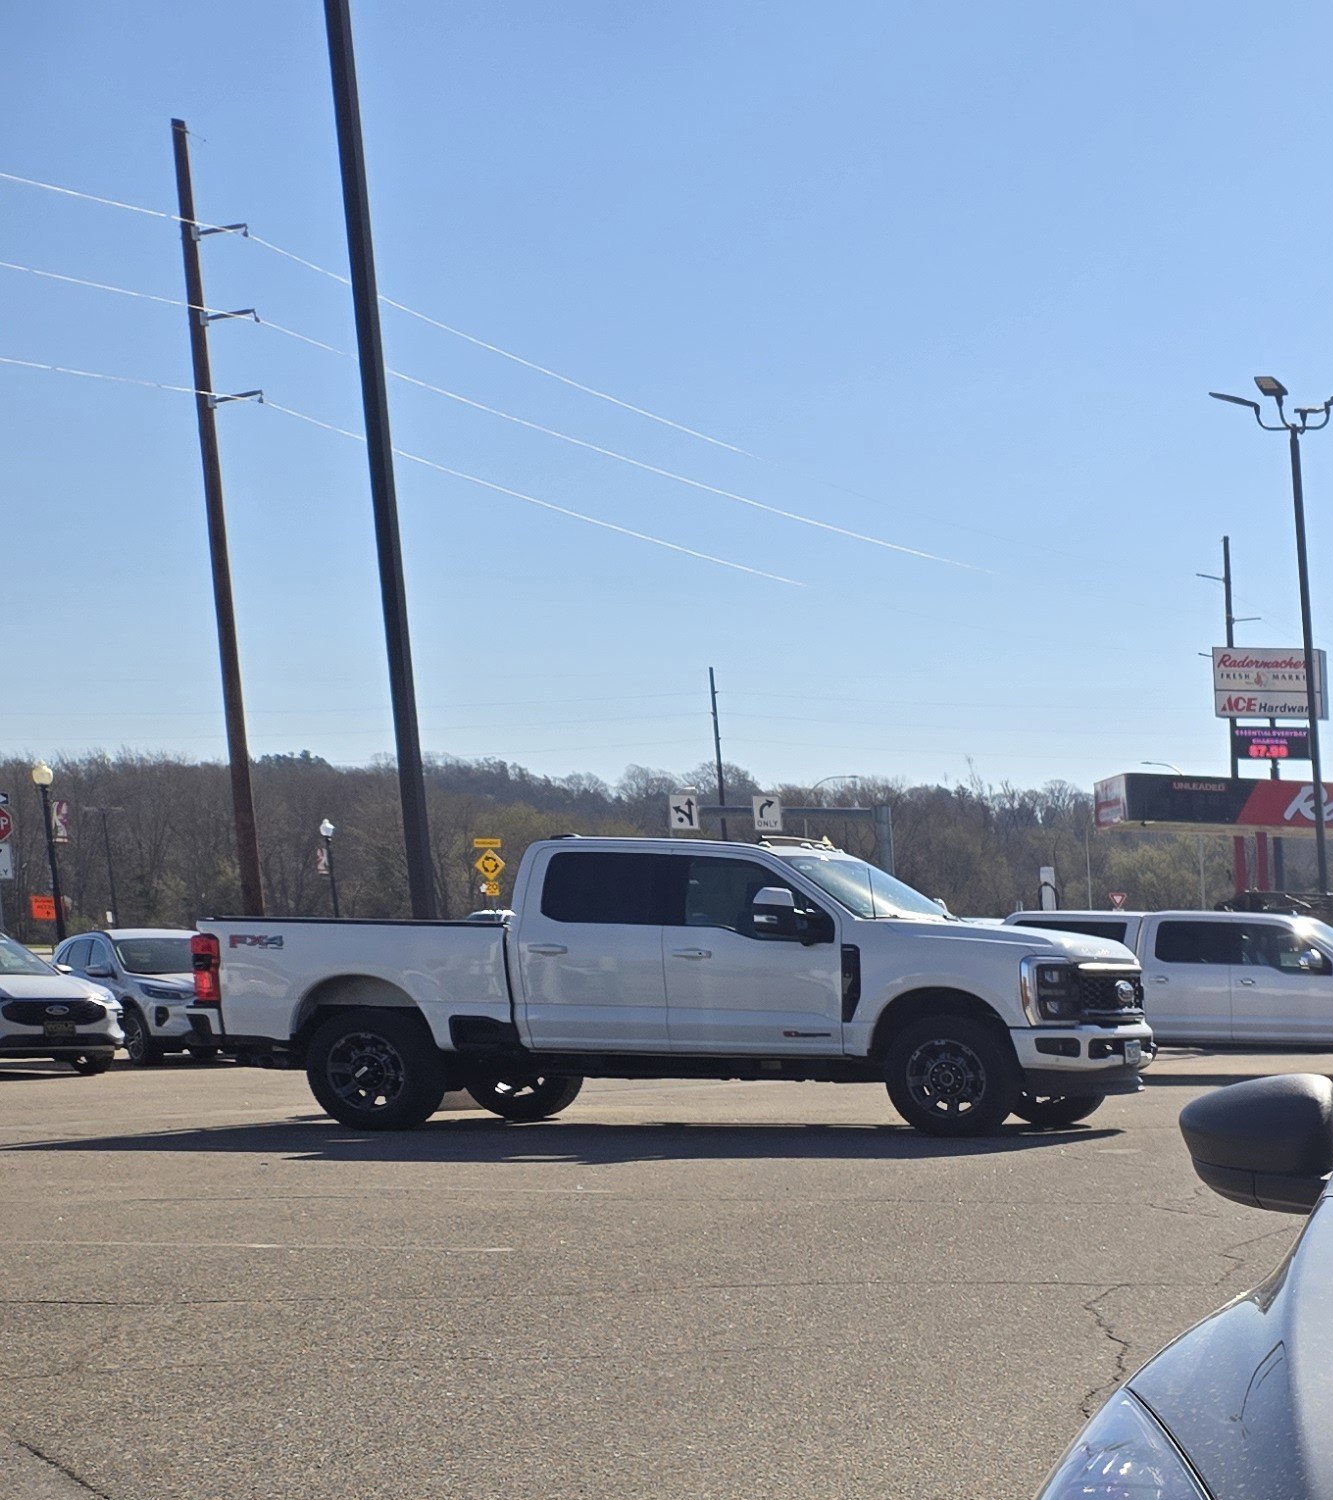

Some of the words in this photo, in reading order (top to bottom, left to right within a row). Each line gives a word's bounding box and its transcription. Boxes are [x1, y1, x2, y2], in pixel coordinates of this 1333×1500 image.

[1221, 694, 1258, 712] ACE
[1258, 702, 1309, 713] Hardwar
[1172, 781, 1226, 792] UNLEADED
[757, 819, 778, 828] ONLY
[229, 934, 284, 949] FX4
